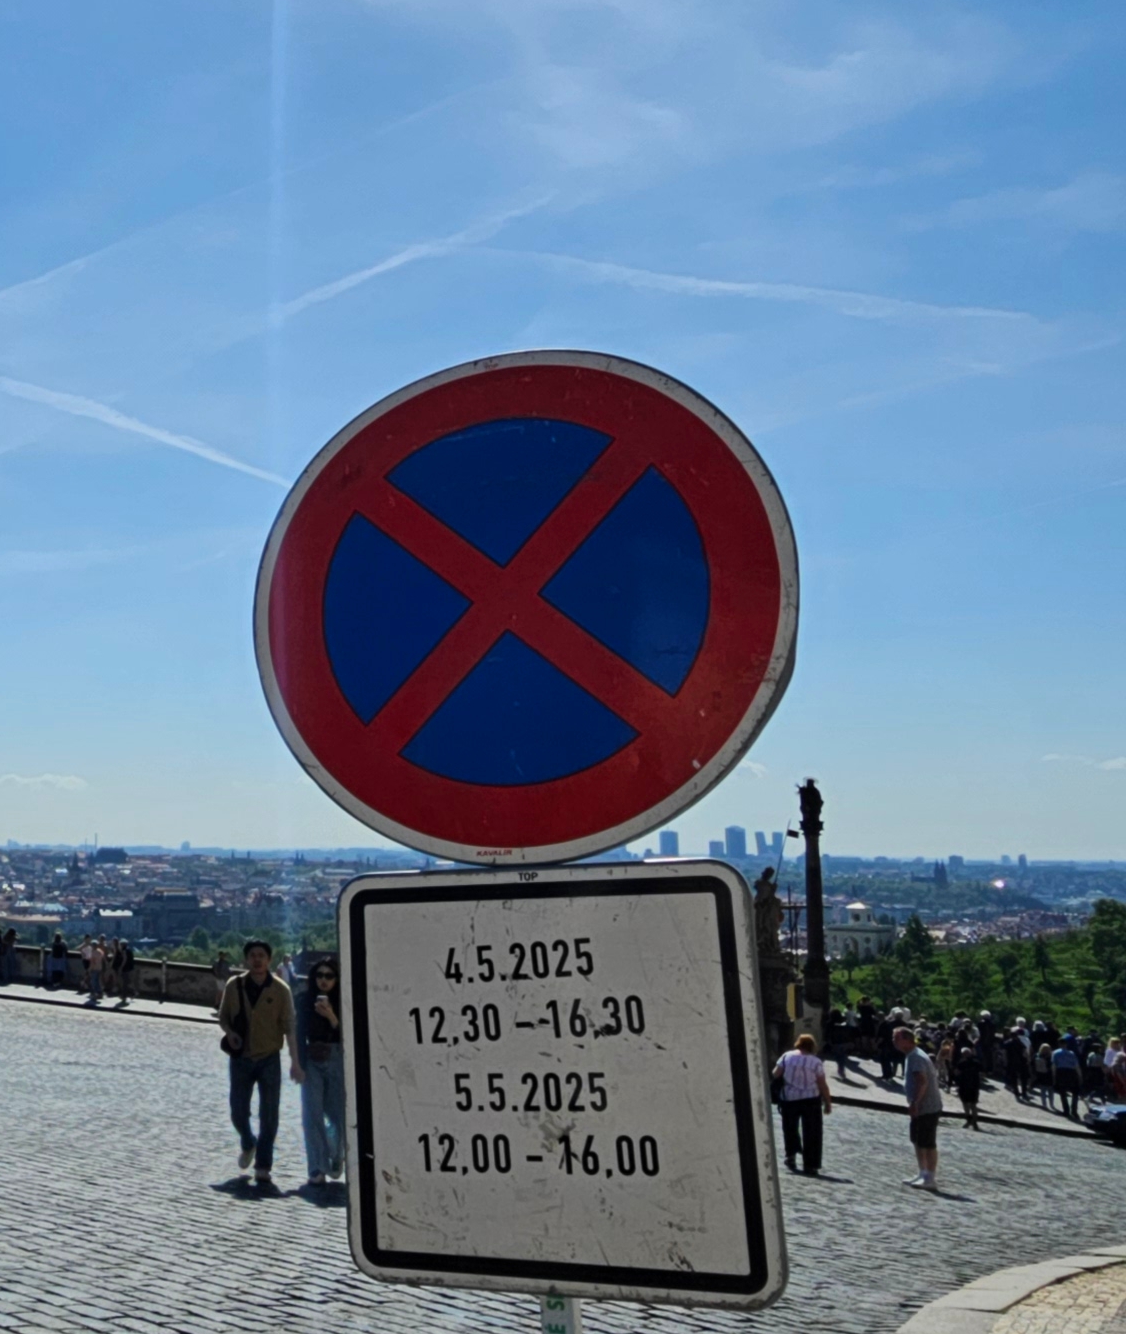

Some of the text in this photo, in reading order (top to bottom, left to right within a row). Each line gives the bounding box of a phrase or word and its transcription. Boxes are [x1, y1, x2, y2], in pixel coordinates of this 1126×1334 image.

[476, 849, 513, 857] KAVALIR
[517, 871, 538, 882] TOP
[444, 937, 594, 984] 4.5.2025
[454, 1072, 608, 1112] 5.5.2025
